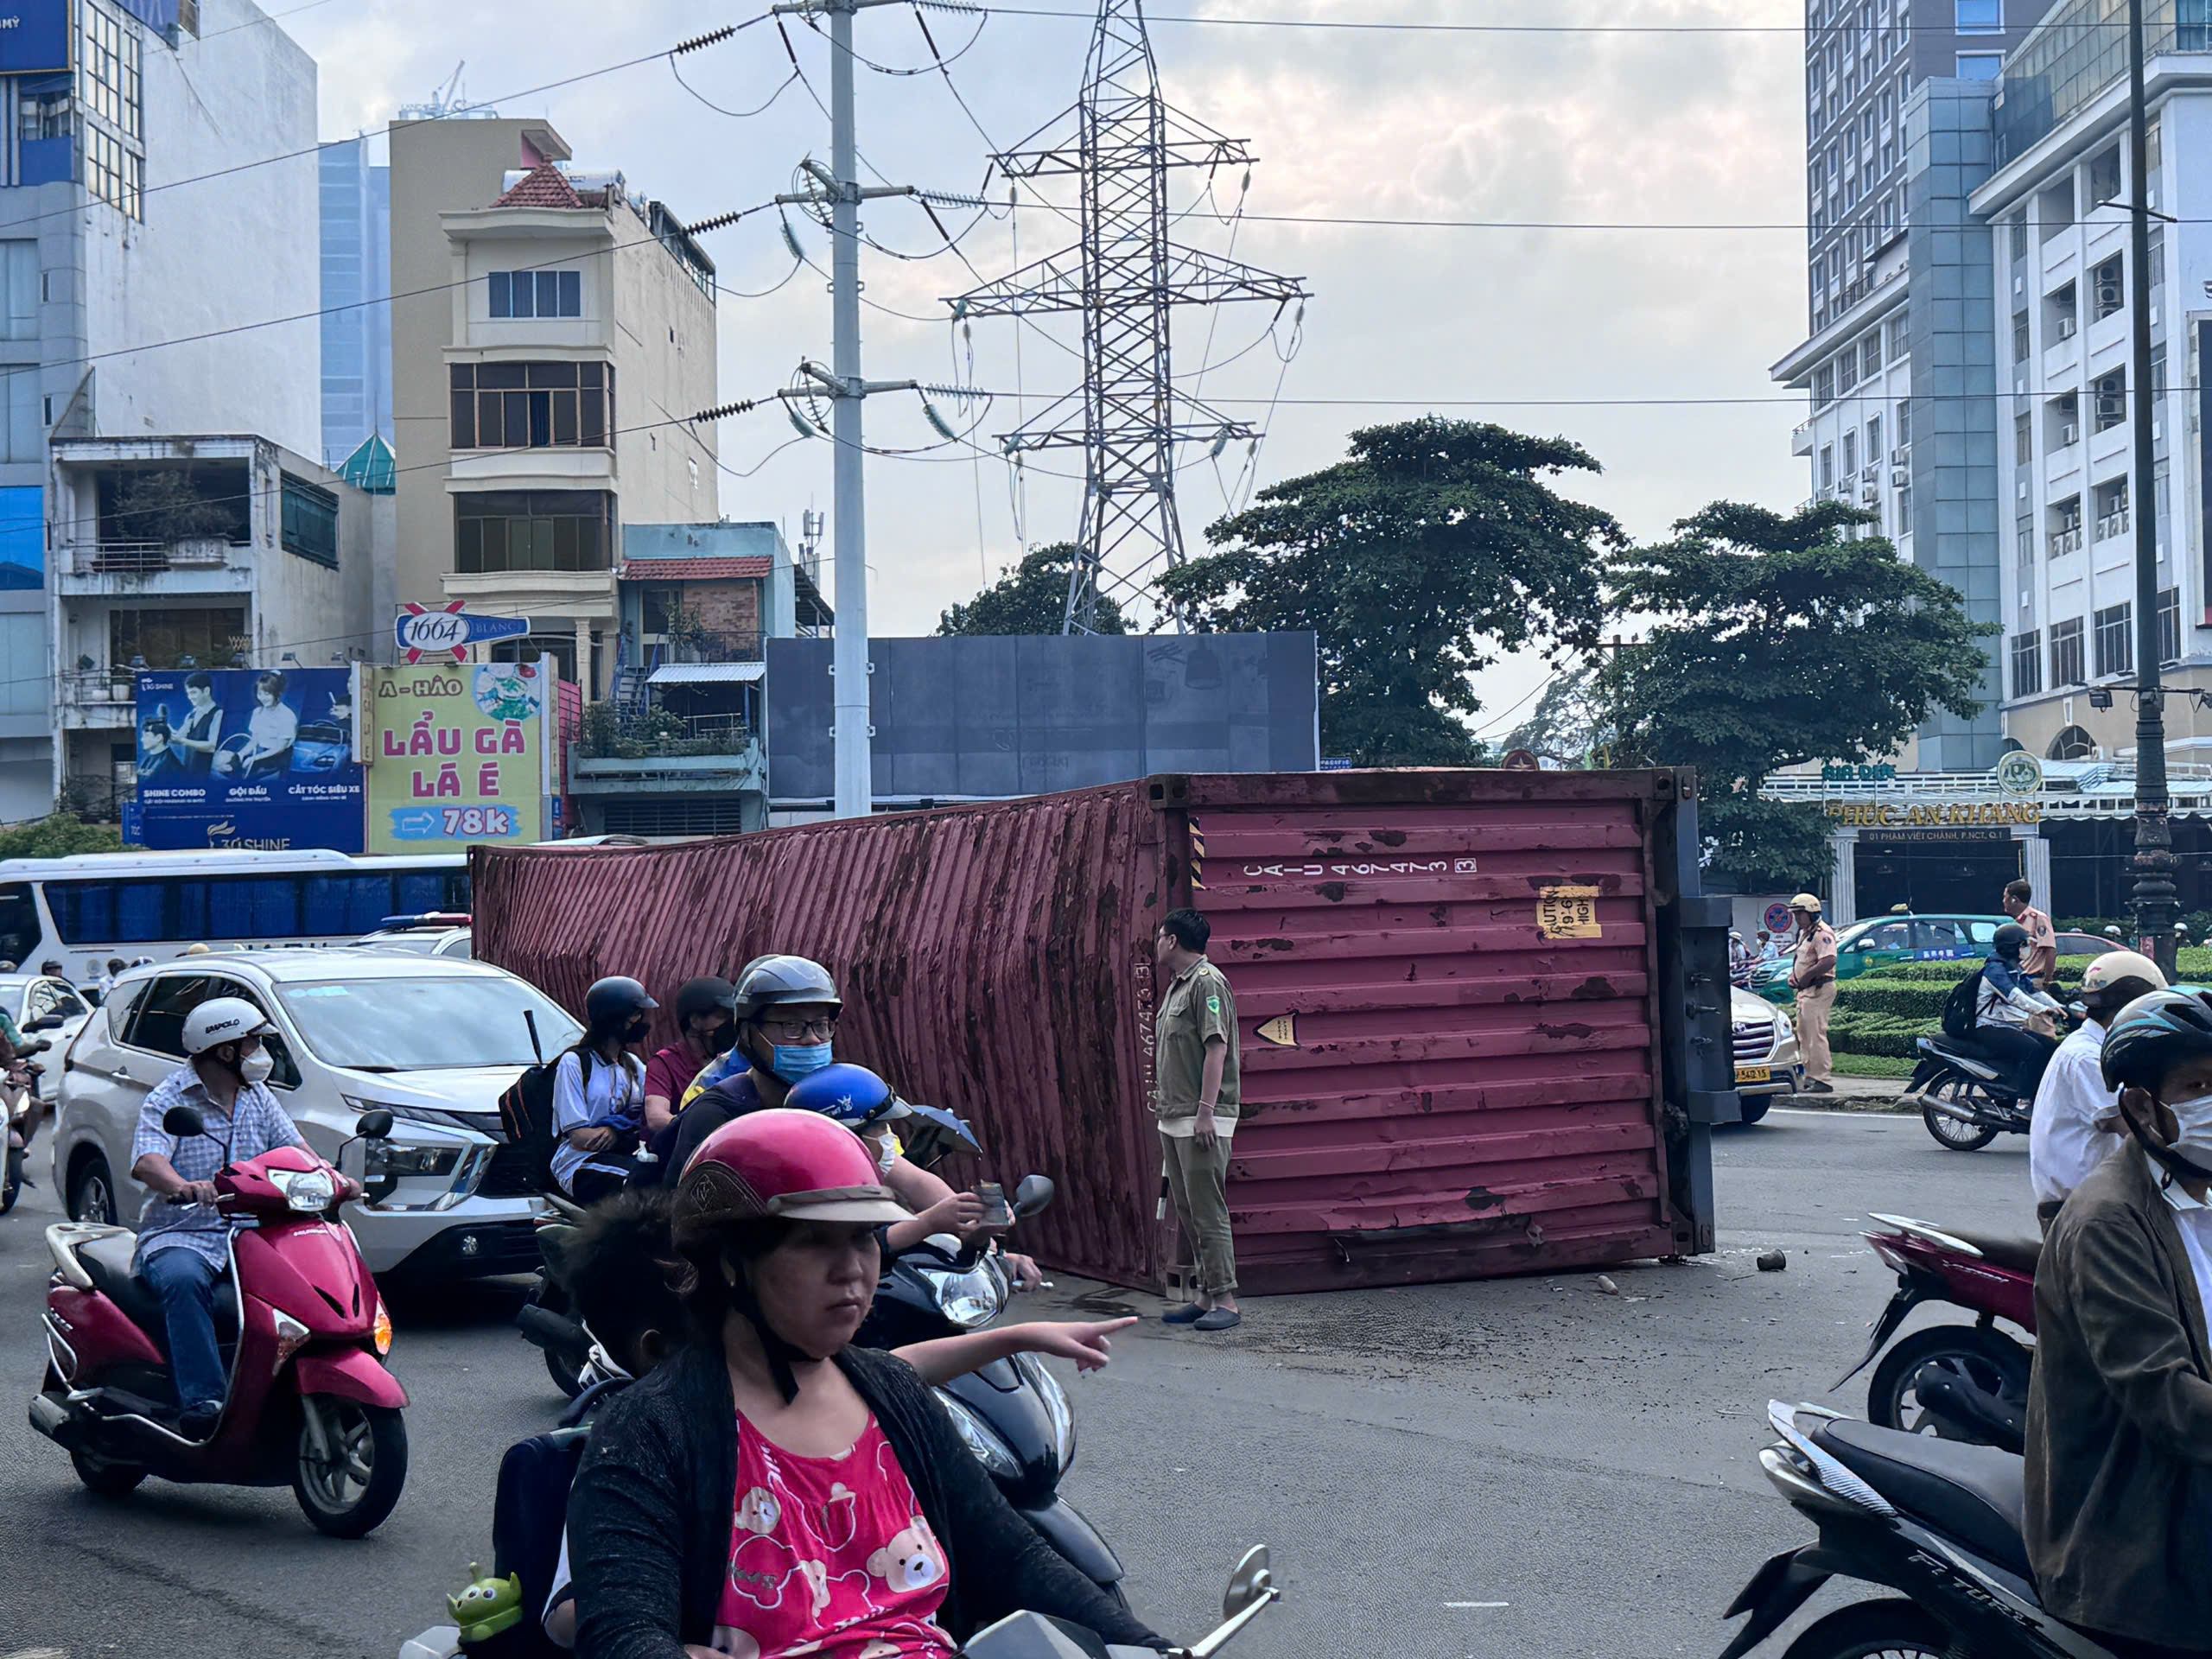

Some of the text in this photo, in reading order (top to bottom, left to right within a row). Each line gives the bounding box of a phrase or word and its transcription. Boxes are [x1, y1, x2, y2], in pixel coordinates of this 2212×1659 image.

[411, 620, 515, 642] 1664 BLANC
[384, 711, 461, 755] LẨU
[475, 720, 525, 753] GÀ
[413, 762, 499, 797] LÁ É
[143, 788, 206, 798] SHINE COMBO
[1906, 804, 1944, 825] AN
[1948, 801, 2042, 825] KHANG
[1243, 859, 1476, 876] CAIU 467473 3
